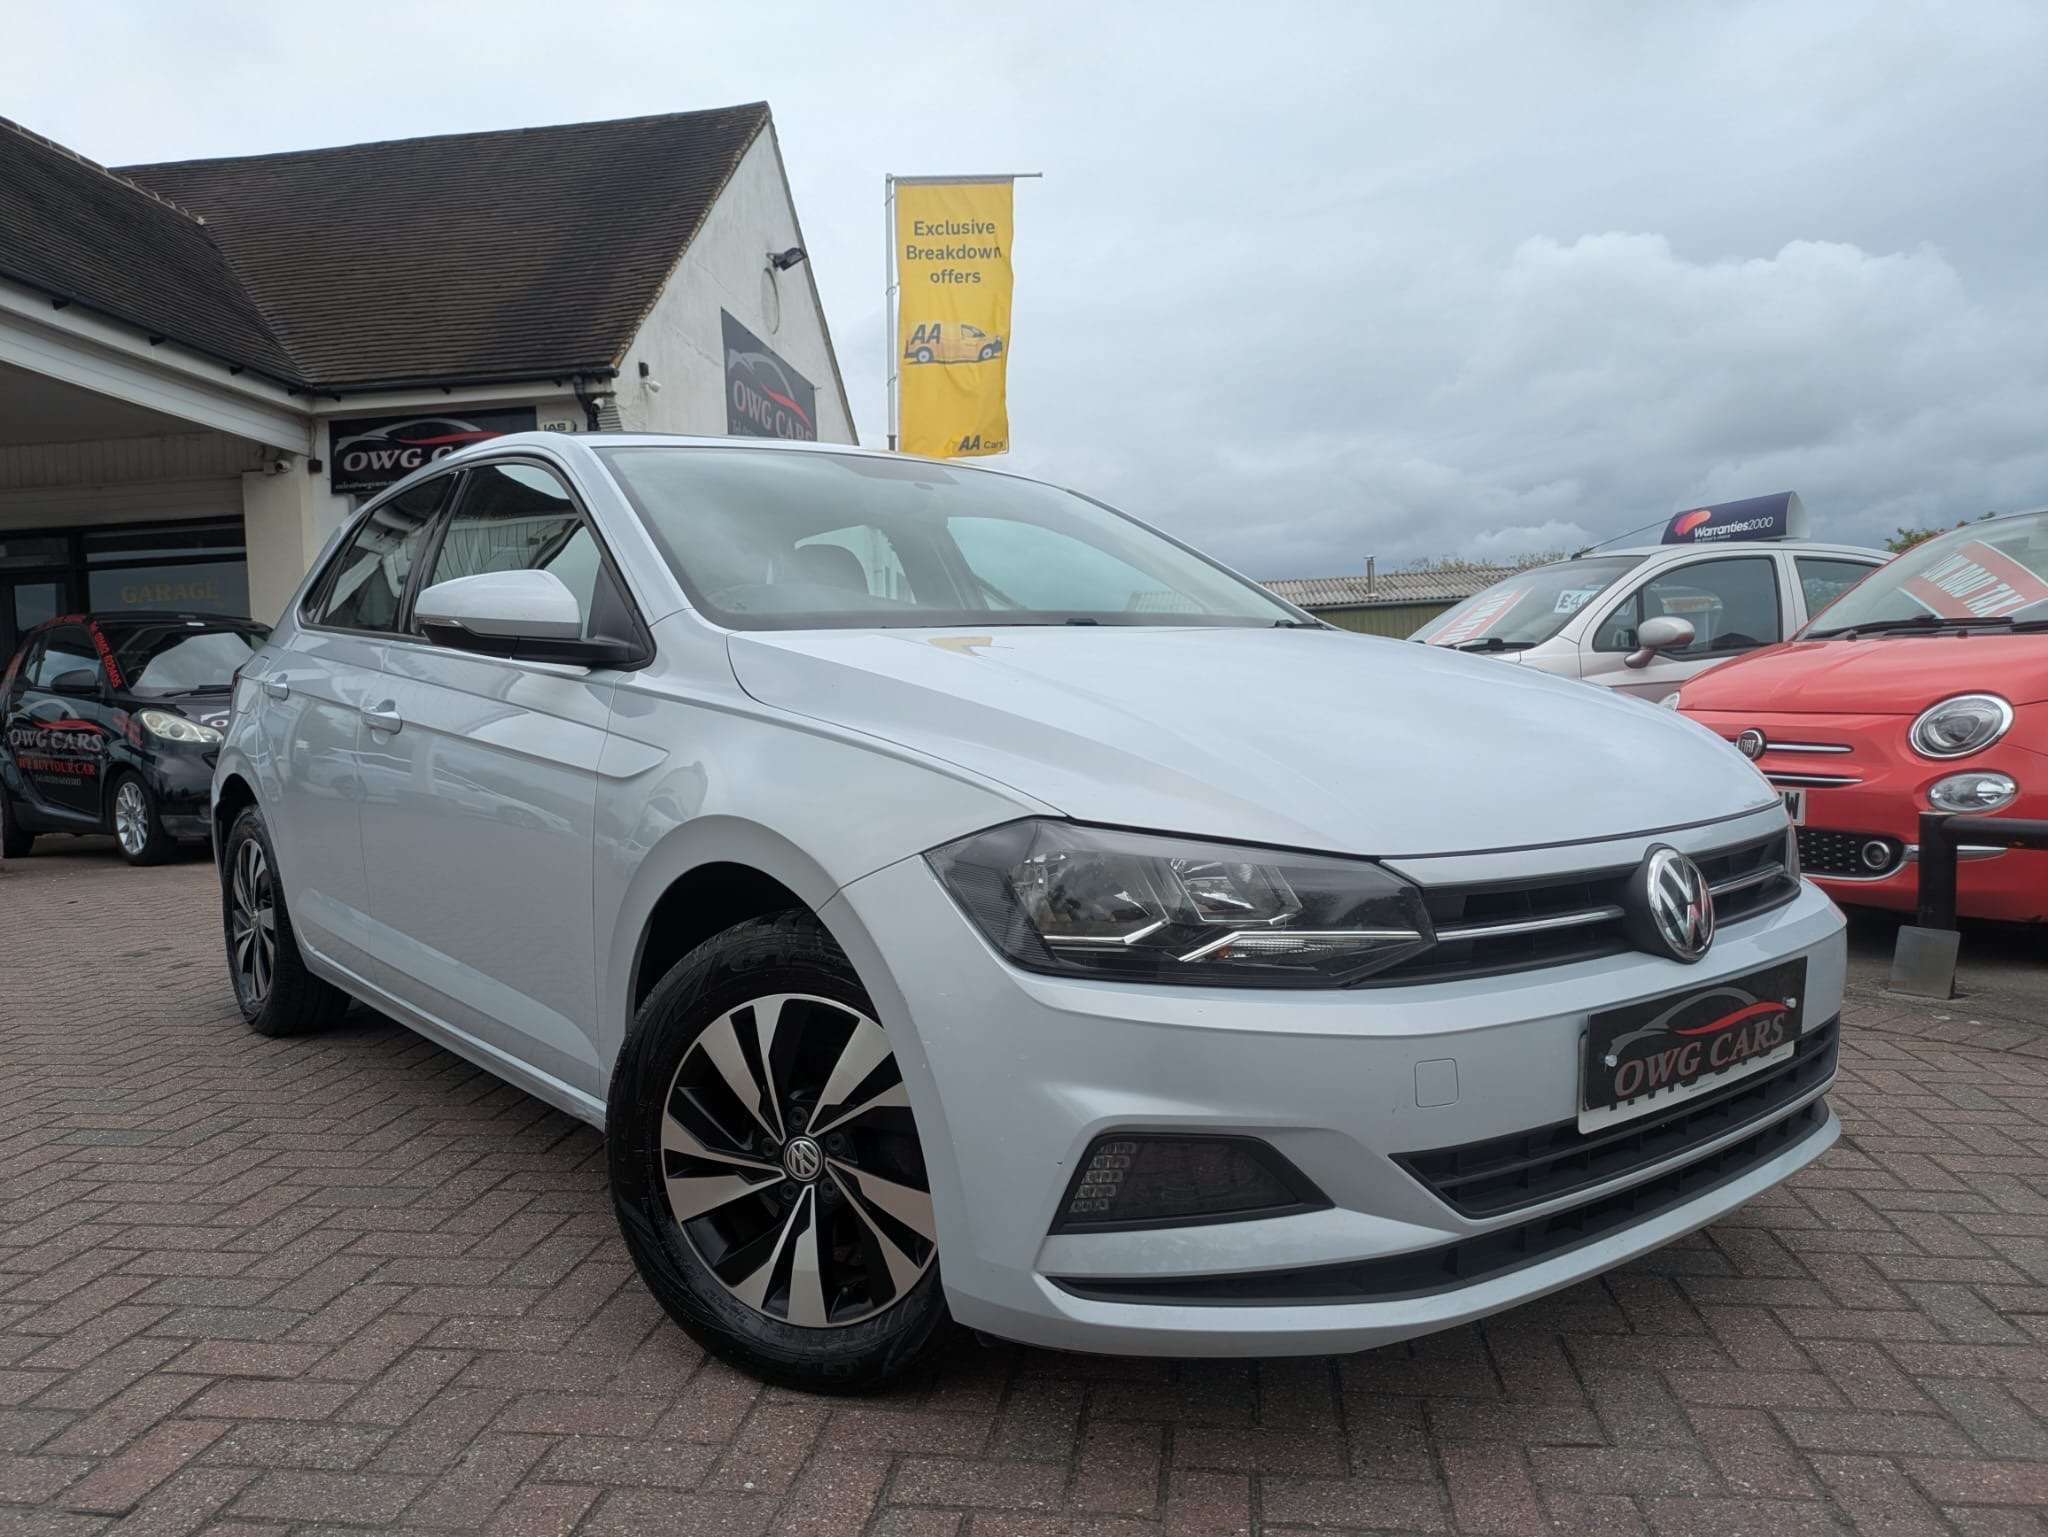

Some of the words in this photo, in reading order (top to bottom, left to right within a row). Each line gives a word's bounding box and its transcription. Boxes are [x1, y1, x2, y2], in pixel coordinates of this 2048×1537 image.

[913, 219, 996, 236] Exclusive
[905, 244, 1002, 260] Breakdown
[930, 269, 982, 284] offers
[910, 323, 941, 345] AA
[733, 380, 772, 431] OWG
[958, 434, 981, 451] AA
[343, 449, 423, 472] OWG
[1694, 516, 1774, 538] Warranties2000
[9, 728, 50, 748] OWG
[50, 731, 102, 752] CARS
[1614, 1041, 1702, 1097] OWG
[1709, 1012, 1786, 1068] CARS
